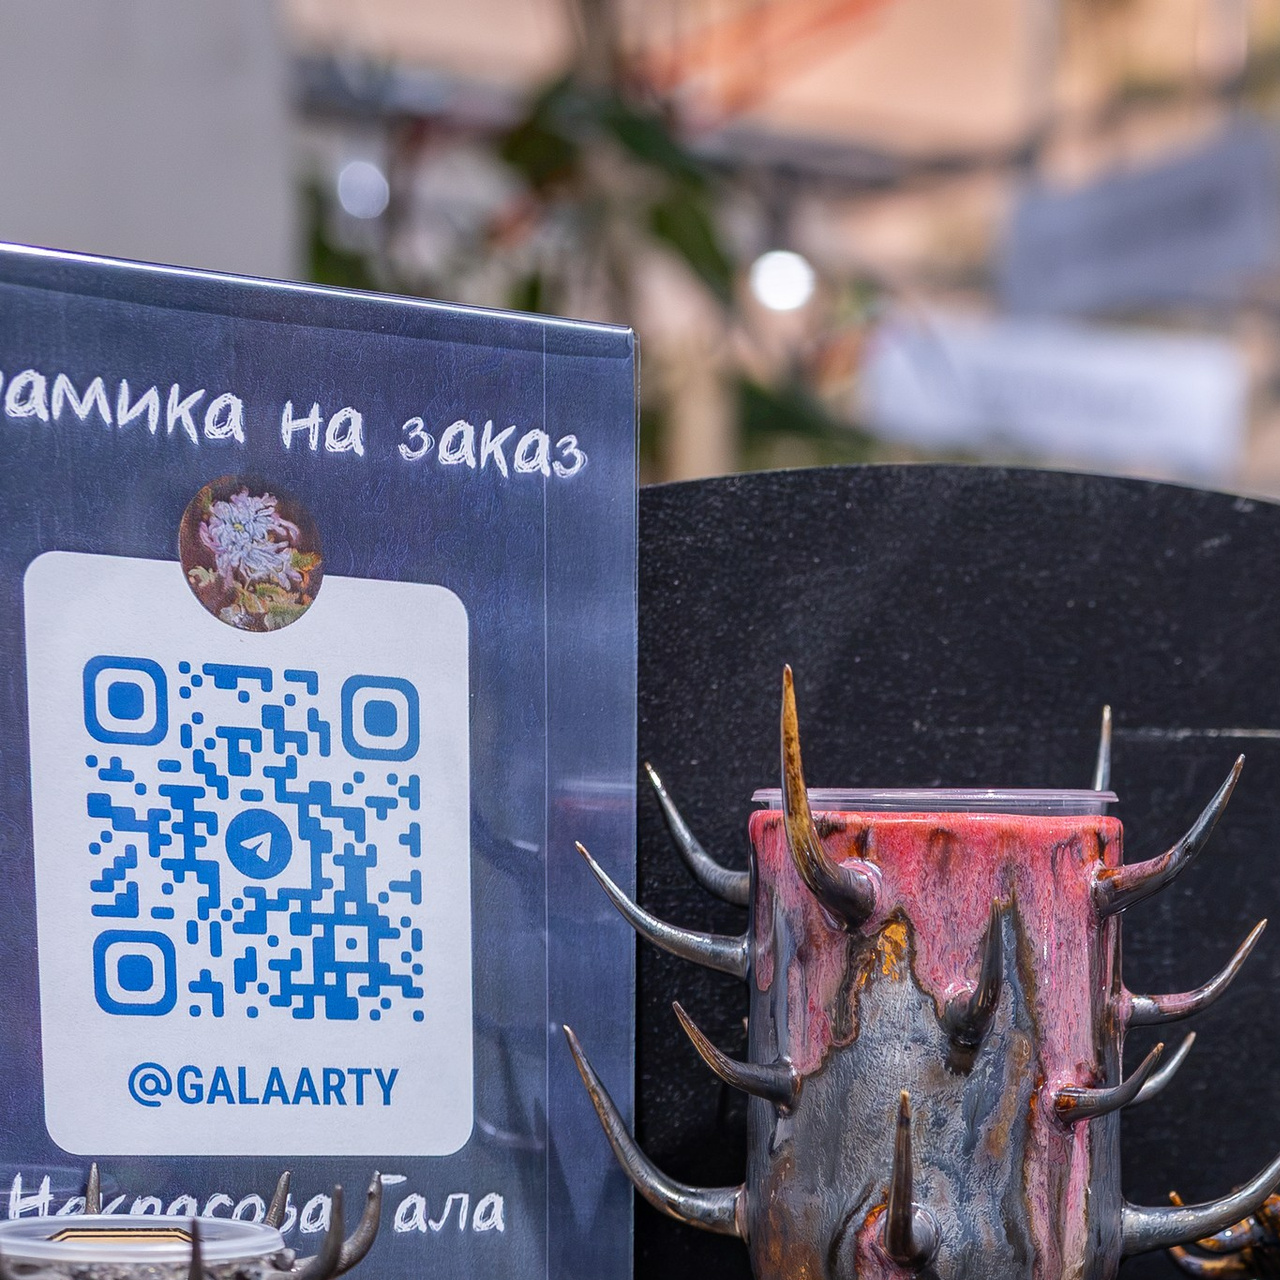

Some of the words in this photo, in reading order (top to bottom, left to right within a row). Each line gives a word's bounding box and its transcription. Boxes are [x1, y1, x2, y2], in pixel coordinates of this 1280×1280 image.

[0, 368, 246, 445] амика
[281, 400, 364, 457] на
[398, 416, 589, 479] заказ
[127, 1061, 400, 1108] @GALAARTY
[380, 1173, 506, 1233] ала
